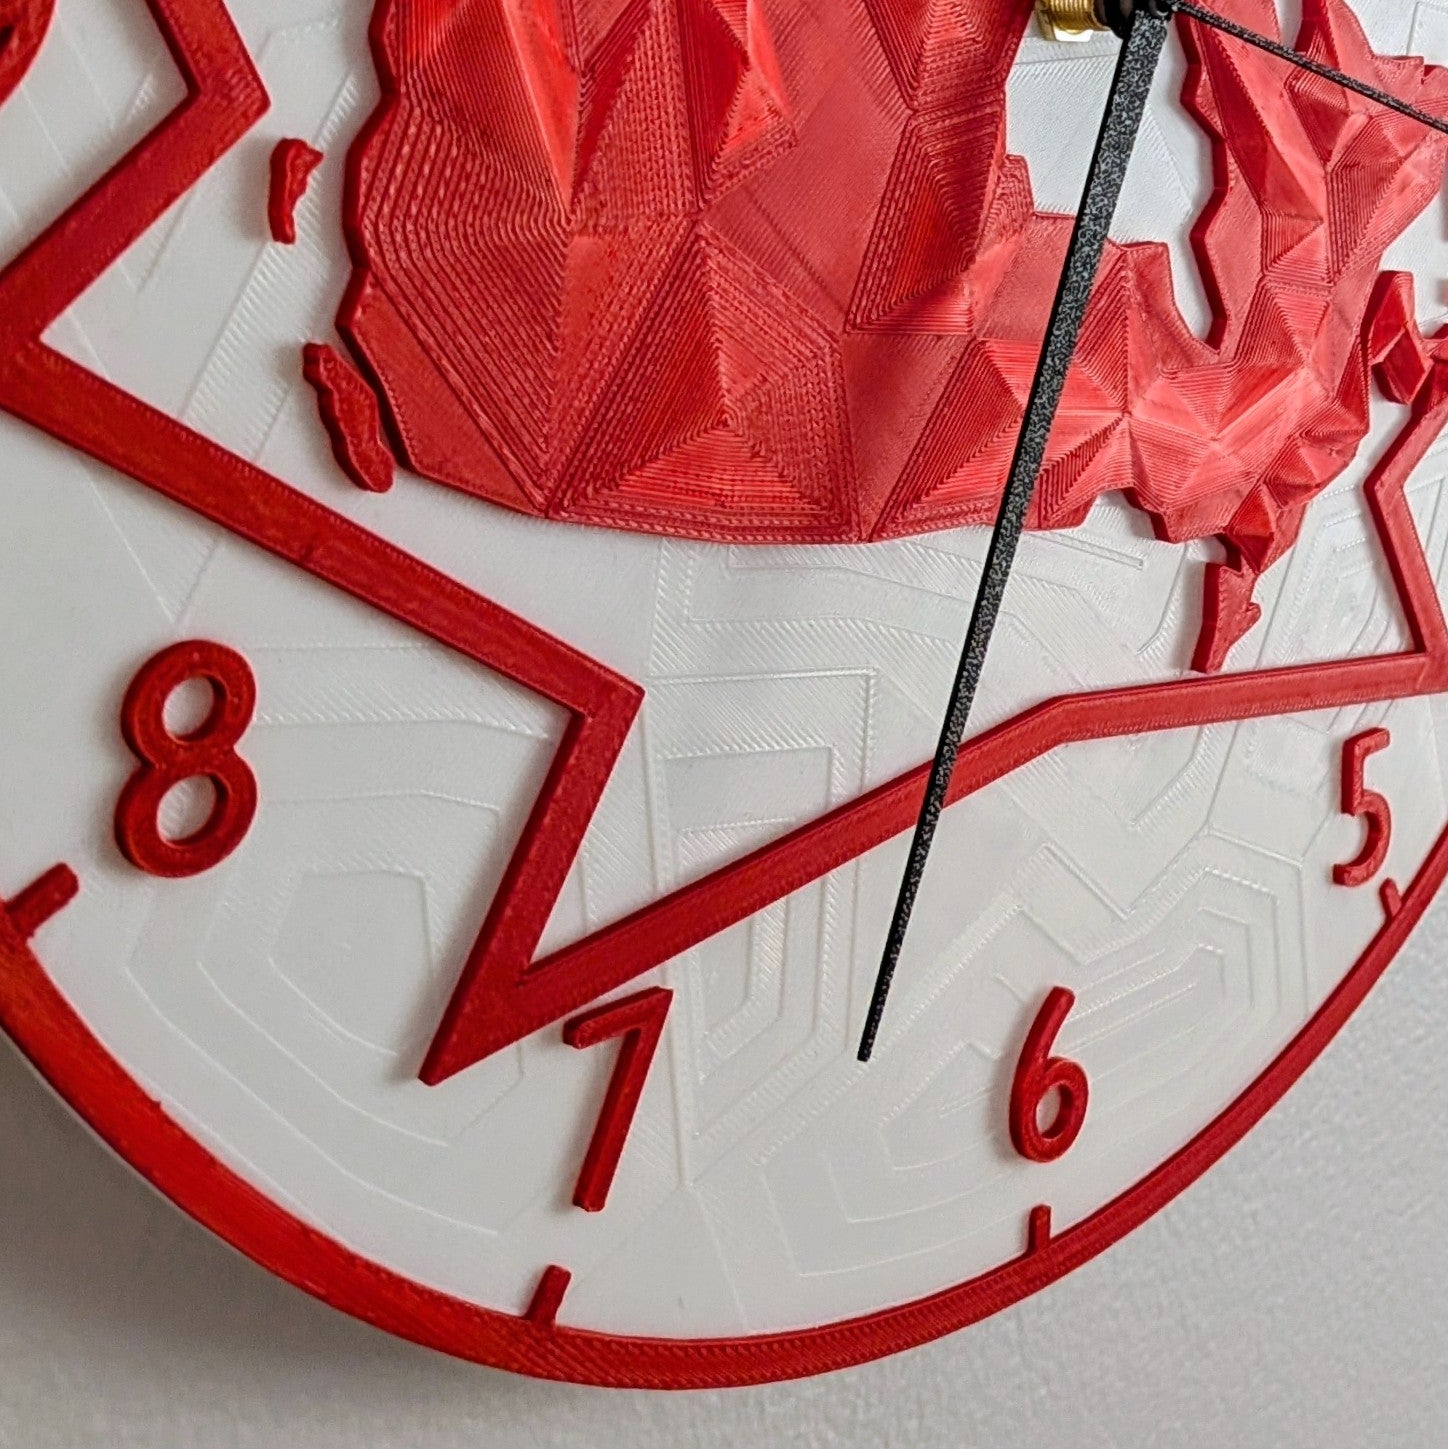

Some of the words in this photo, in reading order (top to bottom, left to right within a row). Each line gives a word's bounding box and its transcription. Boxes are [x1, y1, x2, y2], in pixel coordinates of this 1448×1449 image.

[109, 639, 258, 879] 8
[1331, 727, 1392, 888] 5
[562, 986, 674, 1213] 7
[1007, 986, 1089, 1164] 6
